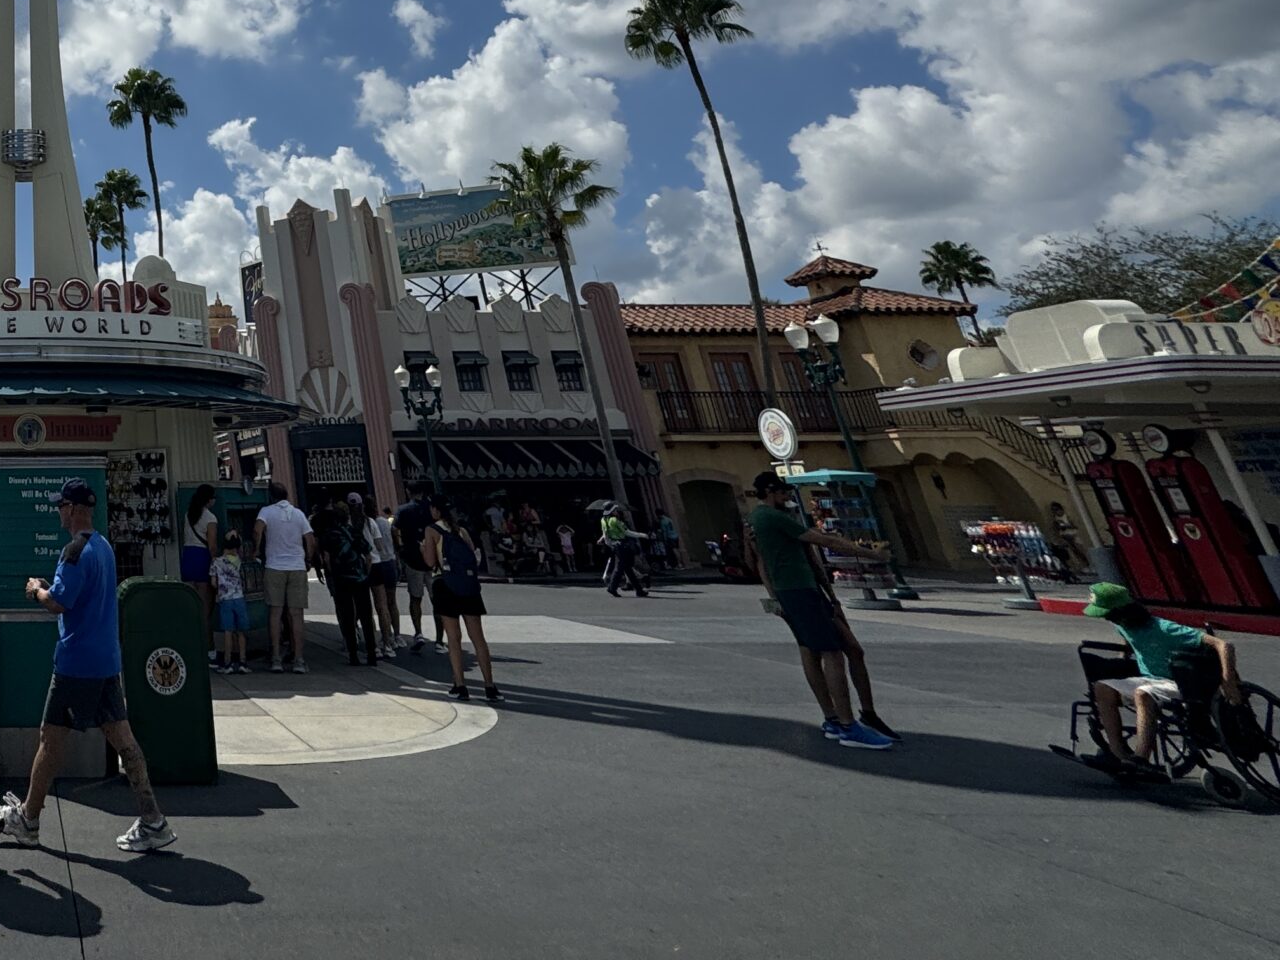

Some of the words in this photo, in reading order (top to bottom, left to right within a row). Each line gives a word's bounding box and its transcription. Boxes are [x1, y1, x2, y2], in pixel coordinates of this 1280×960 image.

[45, 316, 152, 335] WORLD
[1134, 324, 1247, 355] SUPER
[457, 418, 599, 432] DARKROOM
[8, 477, 32, 486] Disney's
[33, 476, 64, 485] Hollywood
[21, 490, 34, 498] Will
